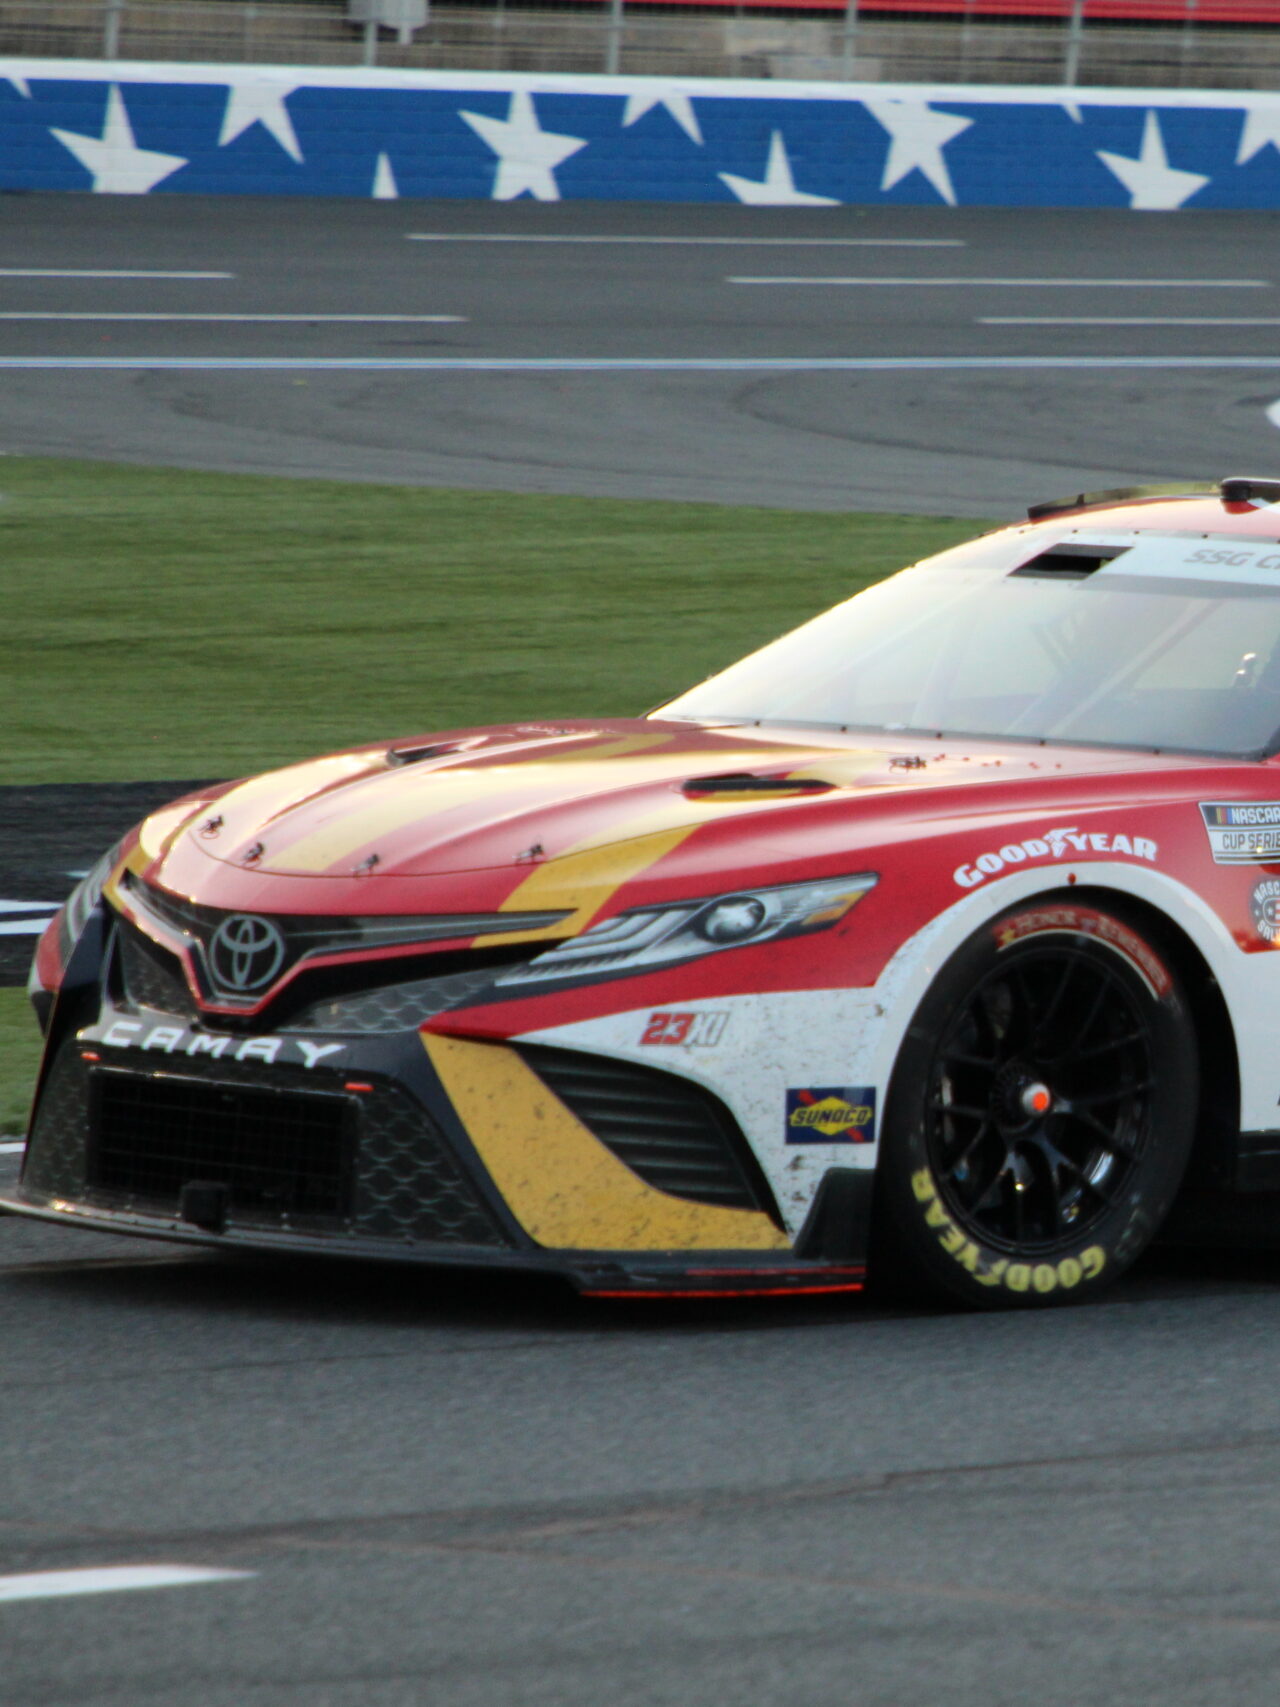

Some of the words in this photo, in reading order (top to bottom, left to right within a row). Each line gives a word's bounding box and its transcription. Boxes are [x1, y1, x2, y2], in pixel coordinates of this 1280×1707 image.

[1182, 550, 1252, 566] SSG
[1222, 834, 1248, 850] CUP
[953, 827, 1158, 888] GOODYEAR
[639, 1011, 727, 1048] 23XI
[792, 1107, 872, 1126] SUNOCO
[910, 1166, 1106, 1293] GOODYEAR
